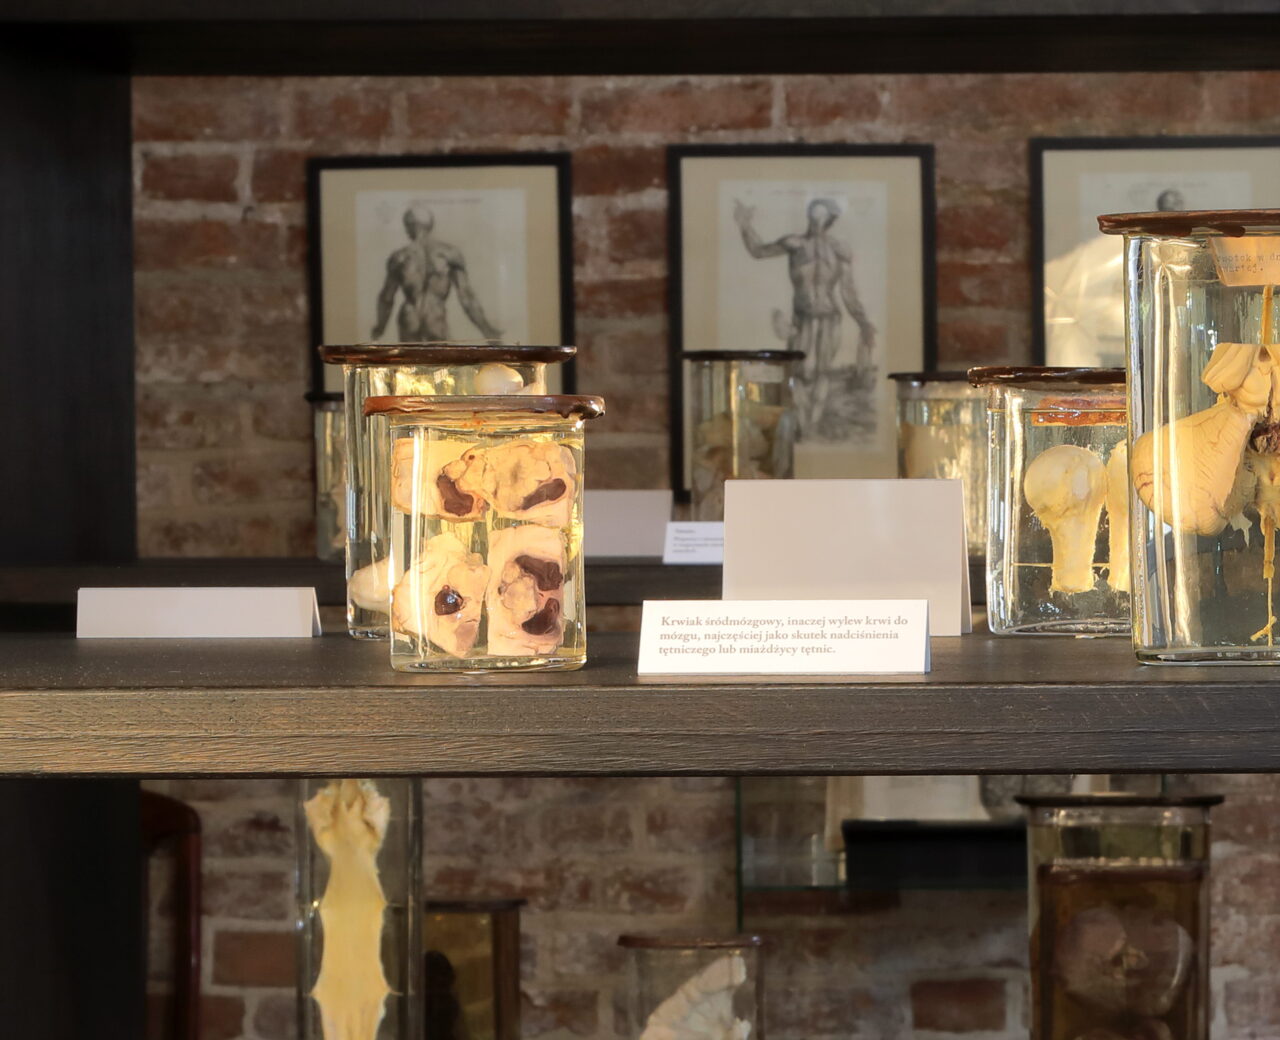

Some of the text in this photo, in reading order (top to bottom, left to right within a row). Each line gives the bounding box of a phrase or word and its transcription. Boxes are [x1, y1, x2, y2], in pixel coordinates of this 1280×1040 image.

[661, 615, 891, 629] Krwiak śródmózgowy, inaczej wylew krwi
[659, 629, 899, 643] mózgu, najczęściej jako skutek nadciśnienia
[658, 643, 836, 657] tętniczego miażdżycy tętnic.
